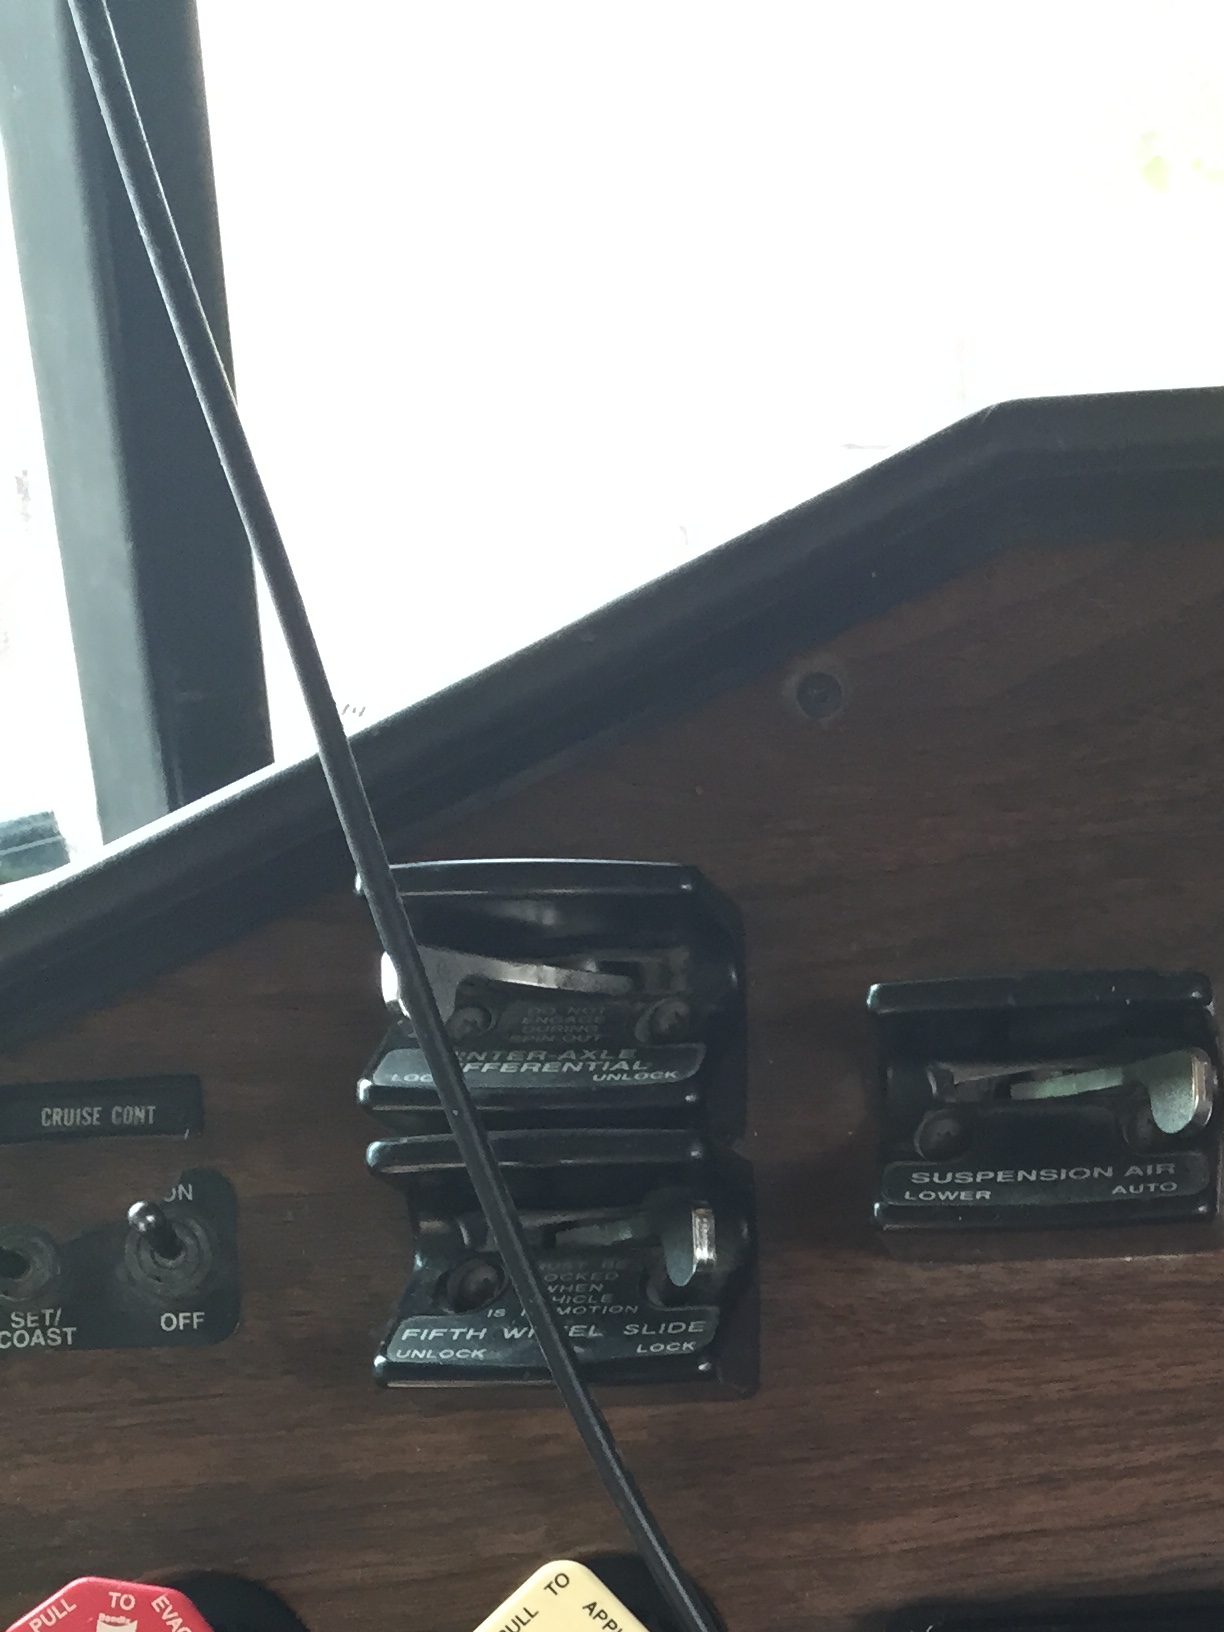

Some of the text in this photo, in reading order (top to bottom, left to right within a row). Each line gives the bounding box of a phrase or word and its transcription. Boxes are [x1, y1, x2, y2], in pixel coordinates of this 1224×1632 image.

[460, 1061, 649, 1073] FFERENTIAL
[392, 1073, 432, 1083] LOC
[593, 1070, 680, 1083] UNLOCK
[41, 1106, 156, 1127] CRUISE CONT
[911, 1164, 1175, 1184] SUSPENSION AIR
[1112, 1182, 1178, 1194] AUTO
[904, 1190, 991, 1201] LOWER
[544, 1272, 619, 1282] OCKED
[552, 1294, 613, 1304] HICLE
[10, 1307, 62, 1329] SET/
[487, 1305, 639, 1318] IS MOTION
[160, 1312, 205, 1331] OFF
[0, 1326, 77, 1349] COAST
[401, 1321, 706, 1341] FIFTH WEL SLIDE
[636, 1341, 697, 1354] LOCK
[397, 1349, 487, 1360] UNLOCK
[543, 1573, 570, 1596] TO
[109, 1592, 136, 1610] TO
